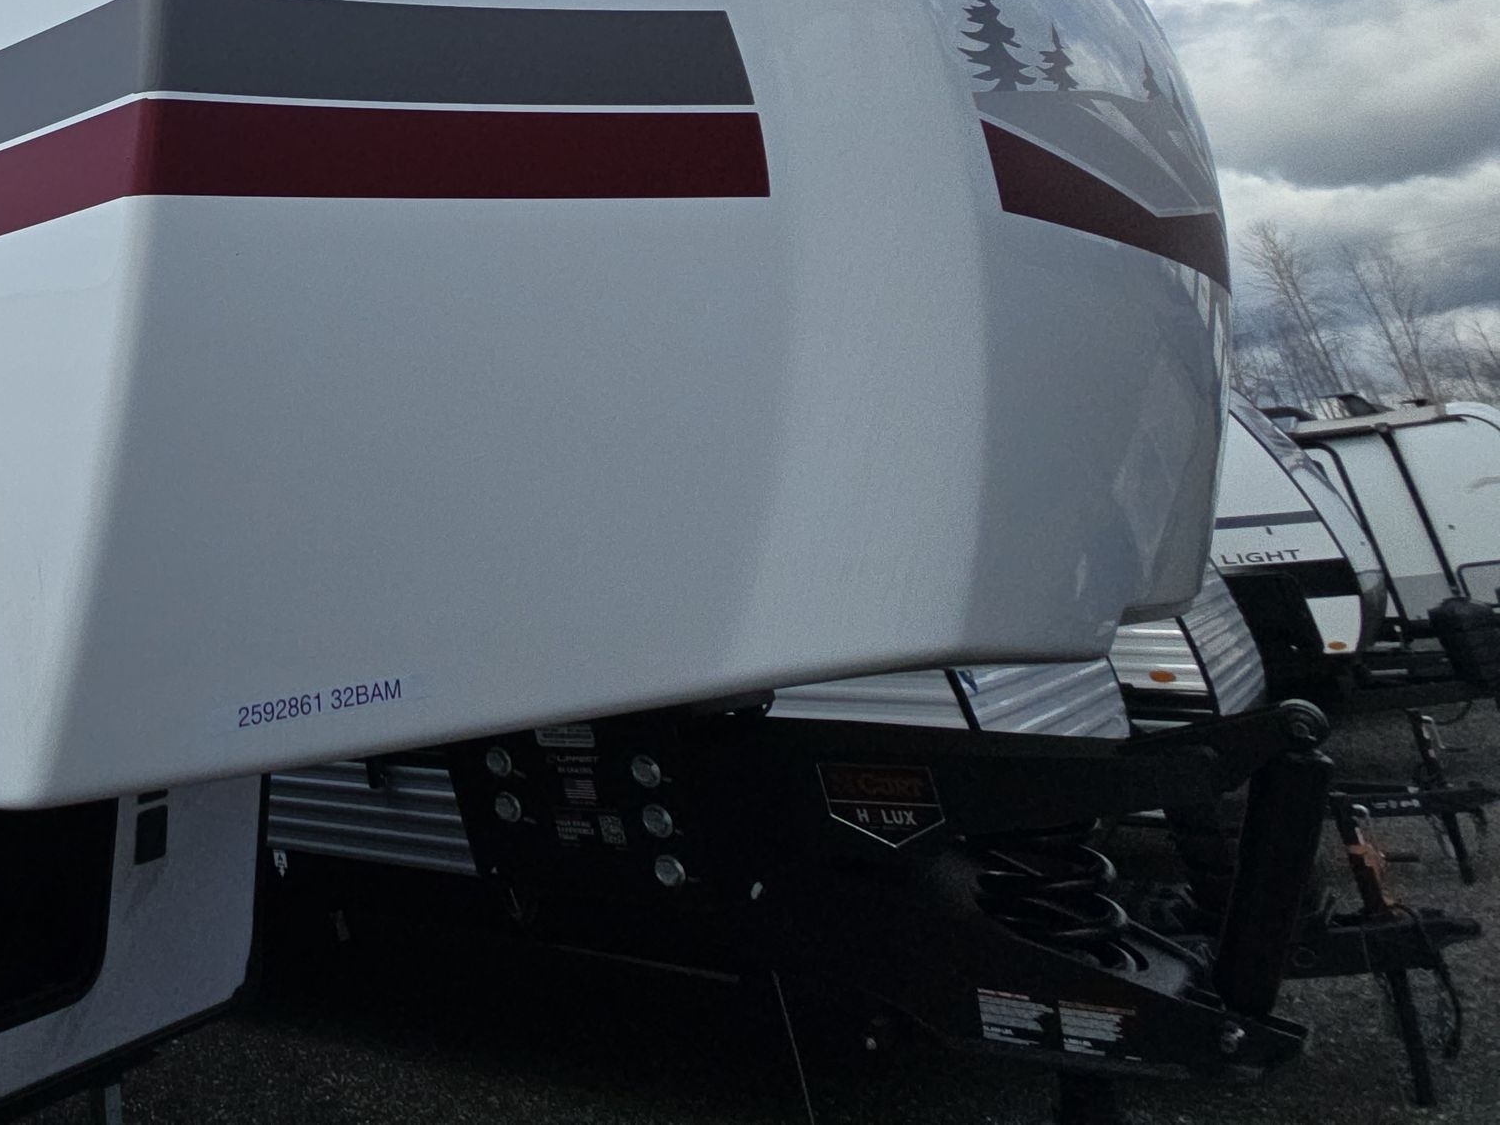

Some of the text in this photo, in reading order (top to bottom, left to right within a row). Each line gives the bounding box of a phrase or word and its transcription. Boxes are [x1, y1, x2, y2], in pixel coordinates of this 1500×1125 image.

[1220, 549, 1300, 566] LIGHT
[237, 678, 402, 728] 2592861 32BAM
